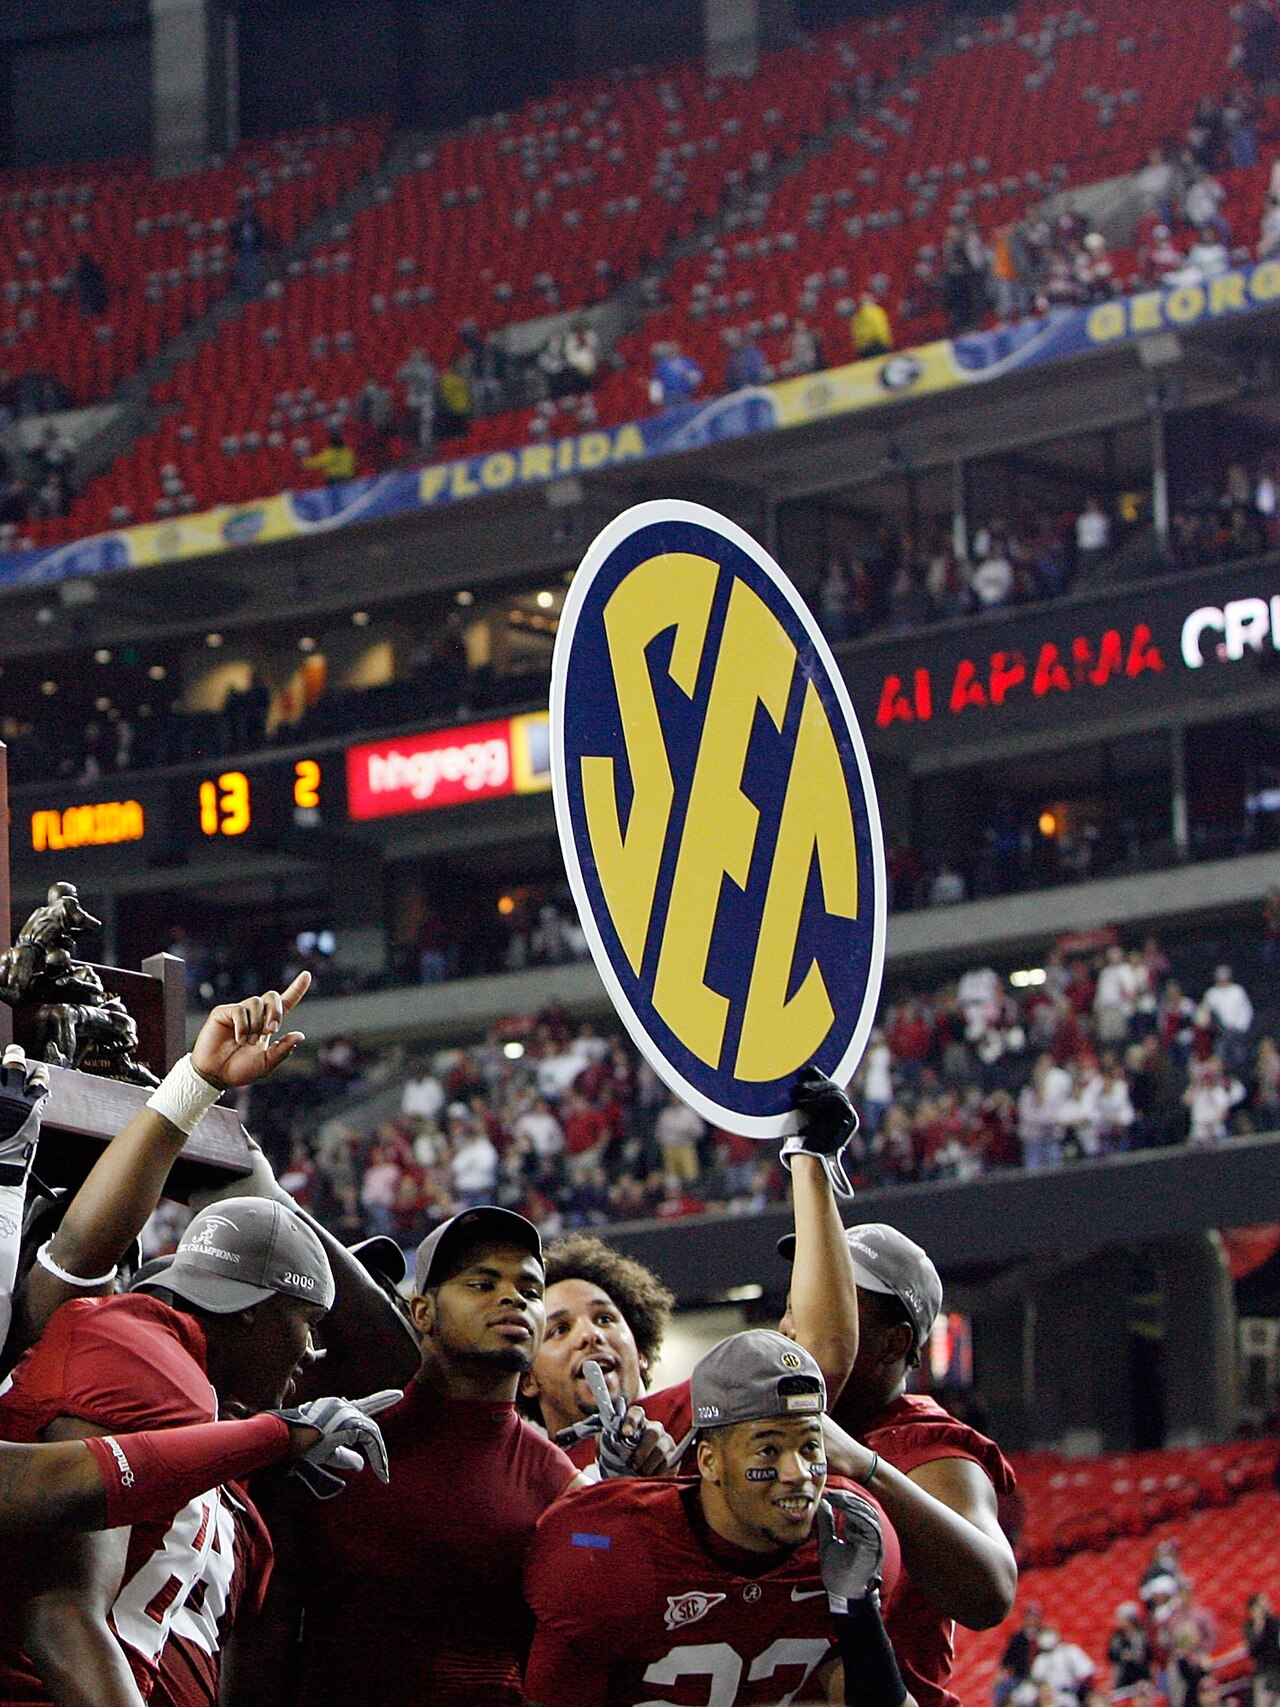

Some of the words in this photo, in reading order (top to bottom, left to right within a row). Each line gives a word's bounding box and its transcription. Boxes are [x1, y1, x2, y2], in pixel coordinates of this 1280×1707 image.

[419, 424, 645, 503] FLORIDA
[200, 771, 251, 836] 13
[294, 759, 321, 808] 2
[32, 801, 144, 852] FLORIDA
[580, 554, 858, 1085] SEC
[283, 1271, 315, 1290] 2009
[746, 1469, 776, 1480] CREAM
[679, 1600, 700, 1618] SEC
